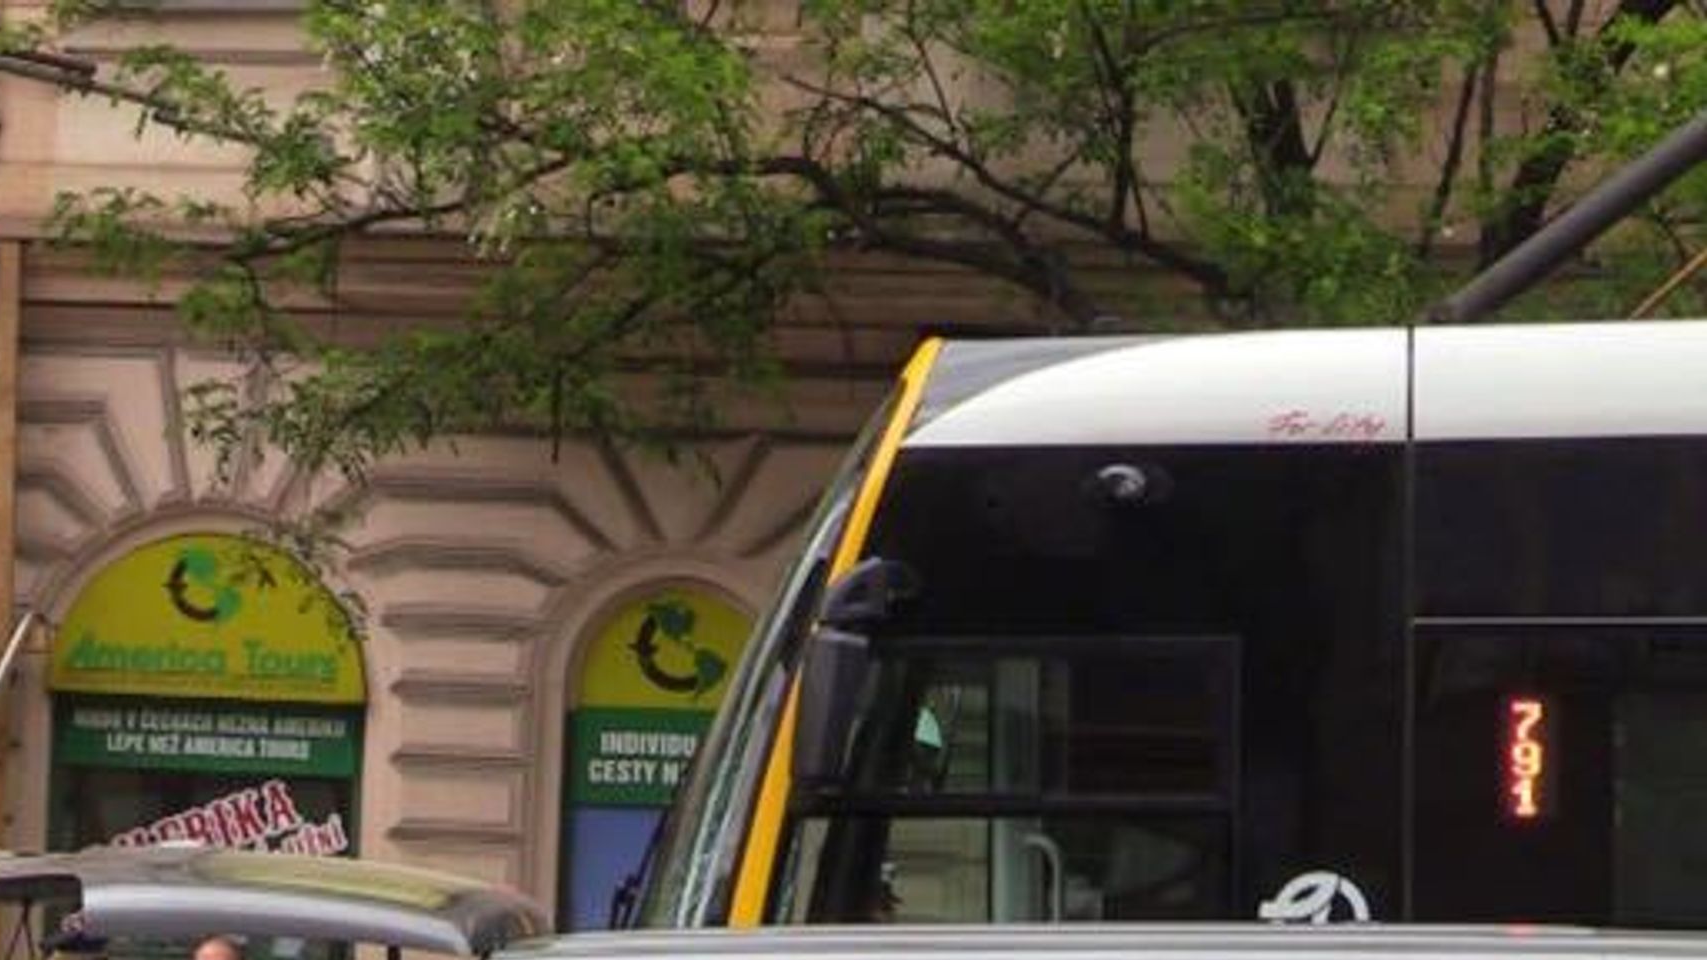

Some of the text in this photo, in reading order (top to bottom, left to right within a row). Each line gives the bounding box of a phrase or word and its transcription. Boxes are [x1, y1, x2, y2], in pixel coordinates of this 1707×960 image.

[71, 629, 337, 682] America Tours
[600, 731, 697, 757] INDIVIDU
[1509, 700, 1543, 817] 791
[587, 760, 656, 785] CESTY
